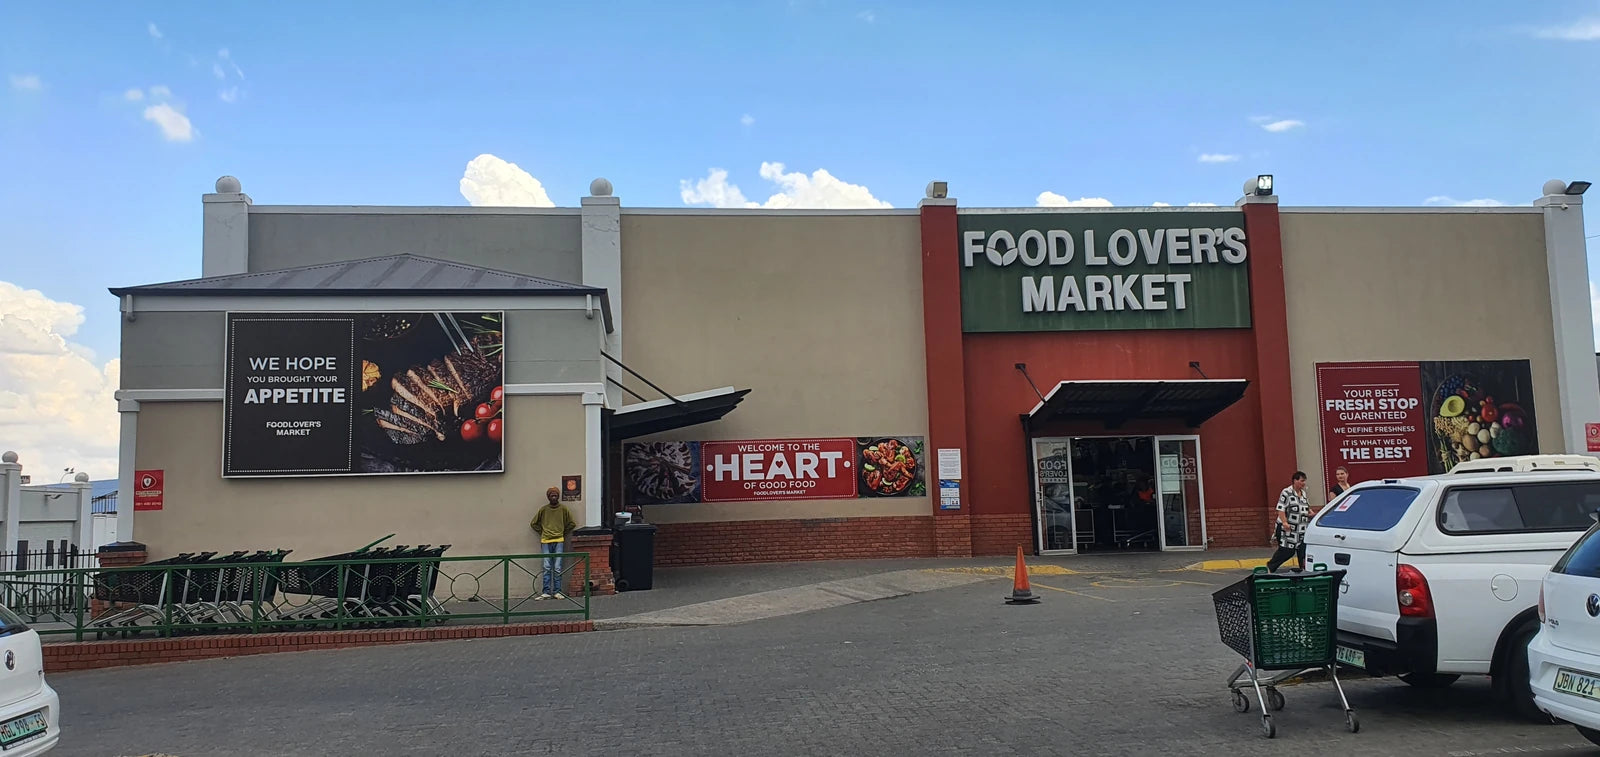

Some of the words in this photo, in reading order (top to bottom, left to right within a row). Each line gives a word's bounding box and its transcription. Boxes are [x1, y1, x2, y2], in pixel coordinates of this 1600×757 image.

[964, 230, 1074, 266] FOOD
[1084, 227, 1247, 265] LOVER'S
[1022, 274, 1191, 312] MARKET
[249, 358, 279, 370] WE
[286, 357, 336, 370] HOPE
[244, 388, 345, 403] APPETITE
[1375, 389, 1399, 397] BEST
[1326, 400, 1374, 411] FRESH
[1379, 398, 1418, 410] STOP
[1340, 411, 1407, 420] GUARENTEED
[738, 444, 784, 452] WELCOME
[1340, 448, 1370, 459] THE
[1374, 447, 1412, 458] BEST
[715, 451, 842, 481] HEART
[759, 481, 786, 489] GOOD
[1557, 673, 1576, 690] JBN
[1576, 676, 1596, 695] 821
